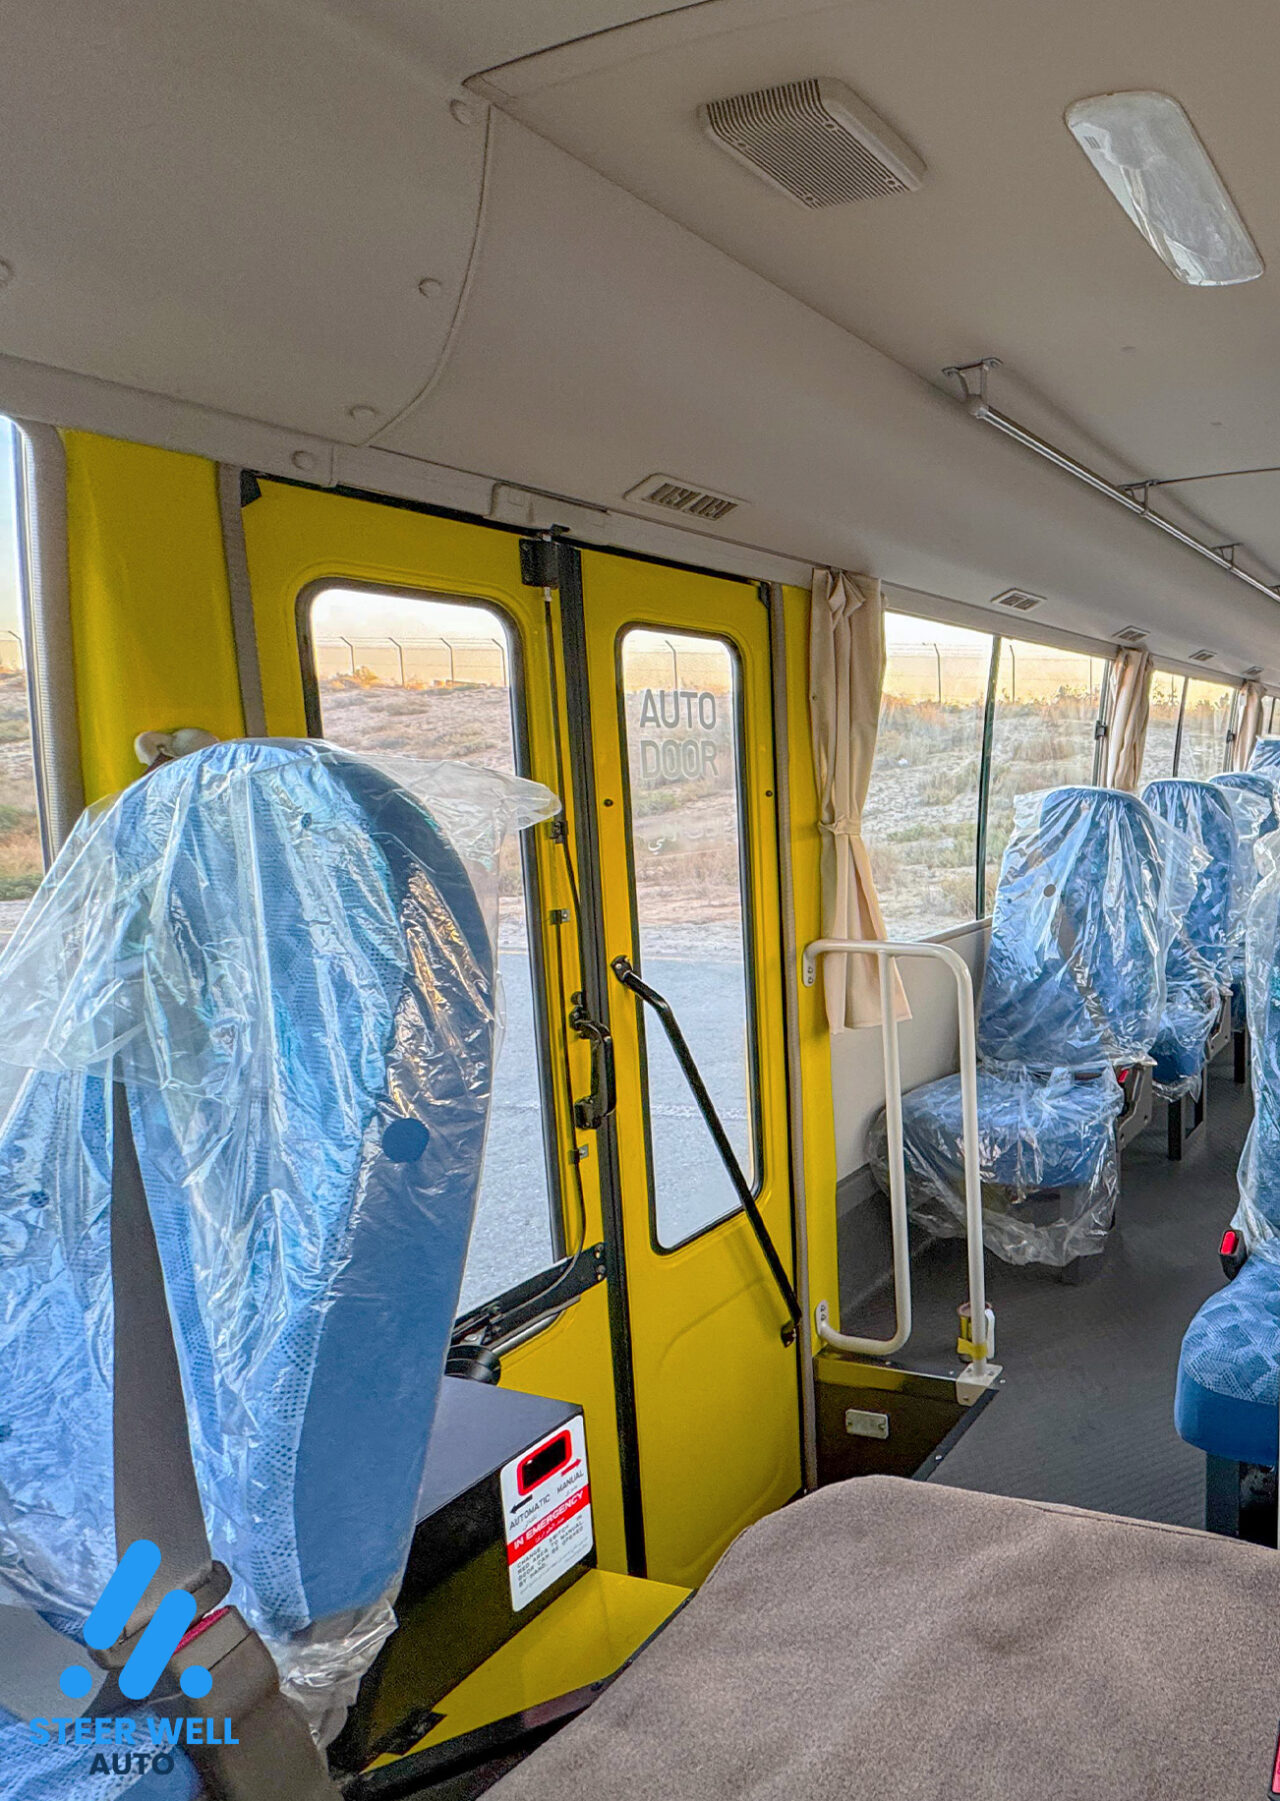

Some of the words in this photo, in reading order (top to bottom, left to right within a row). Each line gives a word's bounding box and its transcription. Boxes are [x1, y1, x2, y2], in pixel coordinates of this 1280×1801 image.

[640, 688, 716, 729] AUTO
[640, 740, 718, 778] DOOR
[509, 1494, 550, 1530] AUTOMATIC
[557, 1470, 584, 1493] MANUAL
[514, 1536, 525, 1550] IN
[525, 1490, 584, 1541] EMERGENCY
[517, 1563, 530, 1574] RED
[533, 1548, 548, 1562] AREA
[551, 1540, 559, 1548] TO
[517, 1547, 540, 1568] CHANGE
[518, 1566, 534, 1580] DOOR
[537, 1554, 550, 1566] CAN
[562, 1525, 584, 1546] OPENED
[518, 1579, 527, 1588] BY
